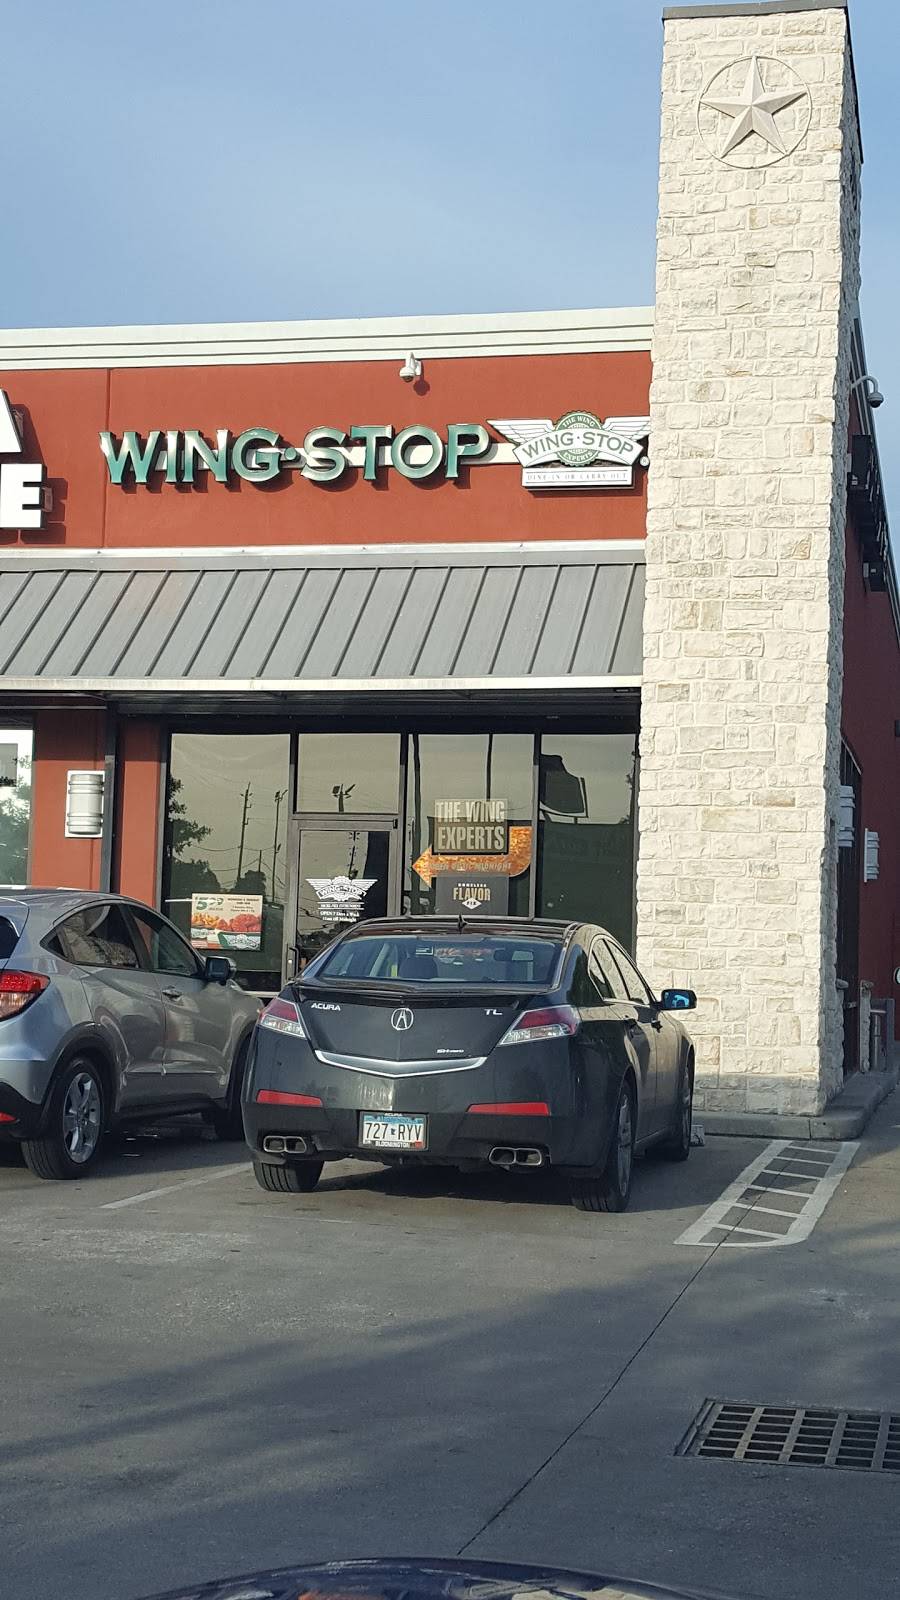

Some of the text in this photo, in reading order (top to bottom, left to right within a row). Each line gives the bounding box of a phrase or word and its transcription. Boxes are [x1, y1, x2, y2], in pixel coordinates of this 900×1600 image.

[562, 416, 596, 427] THE WING
[564, 451, 594, 462] EXPERTS
[435, 800, 505, 823] THE WING
[437, 826, 505, 850] EXPERTS
[453, 887, 491, 901] FLAVOR
[311, 1002, 341, 1012] ACURA
[484, 1008, 503, 1016] TL
[365, 1122, 422, 1141] 727 RYV
